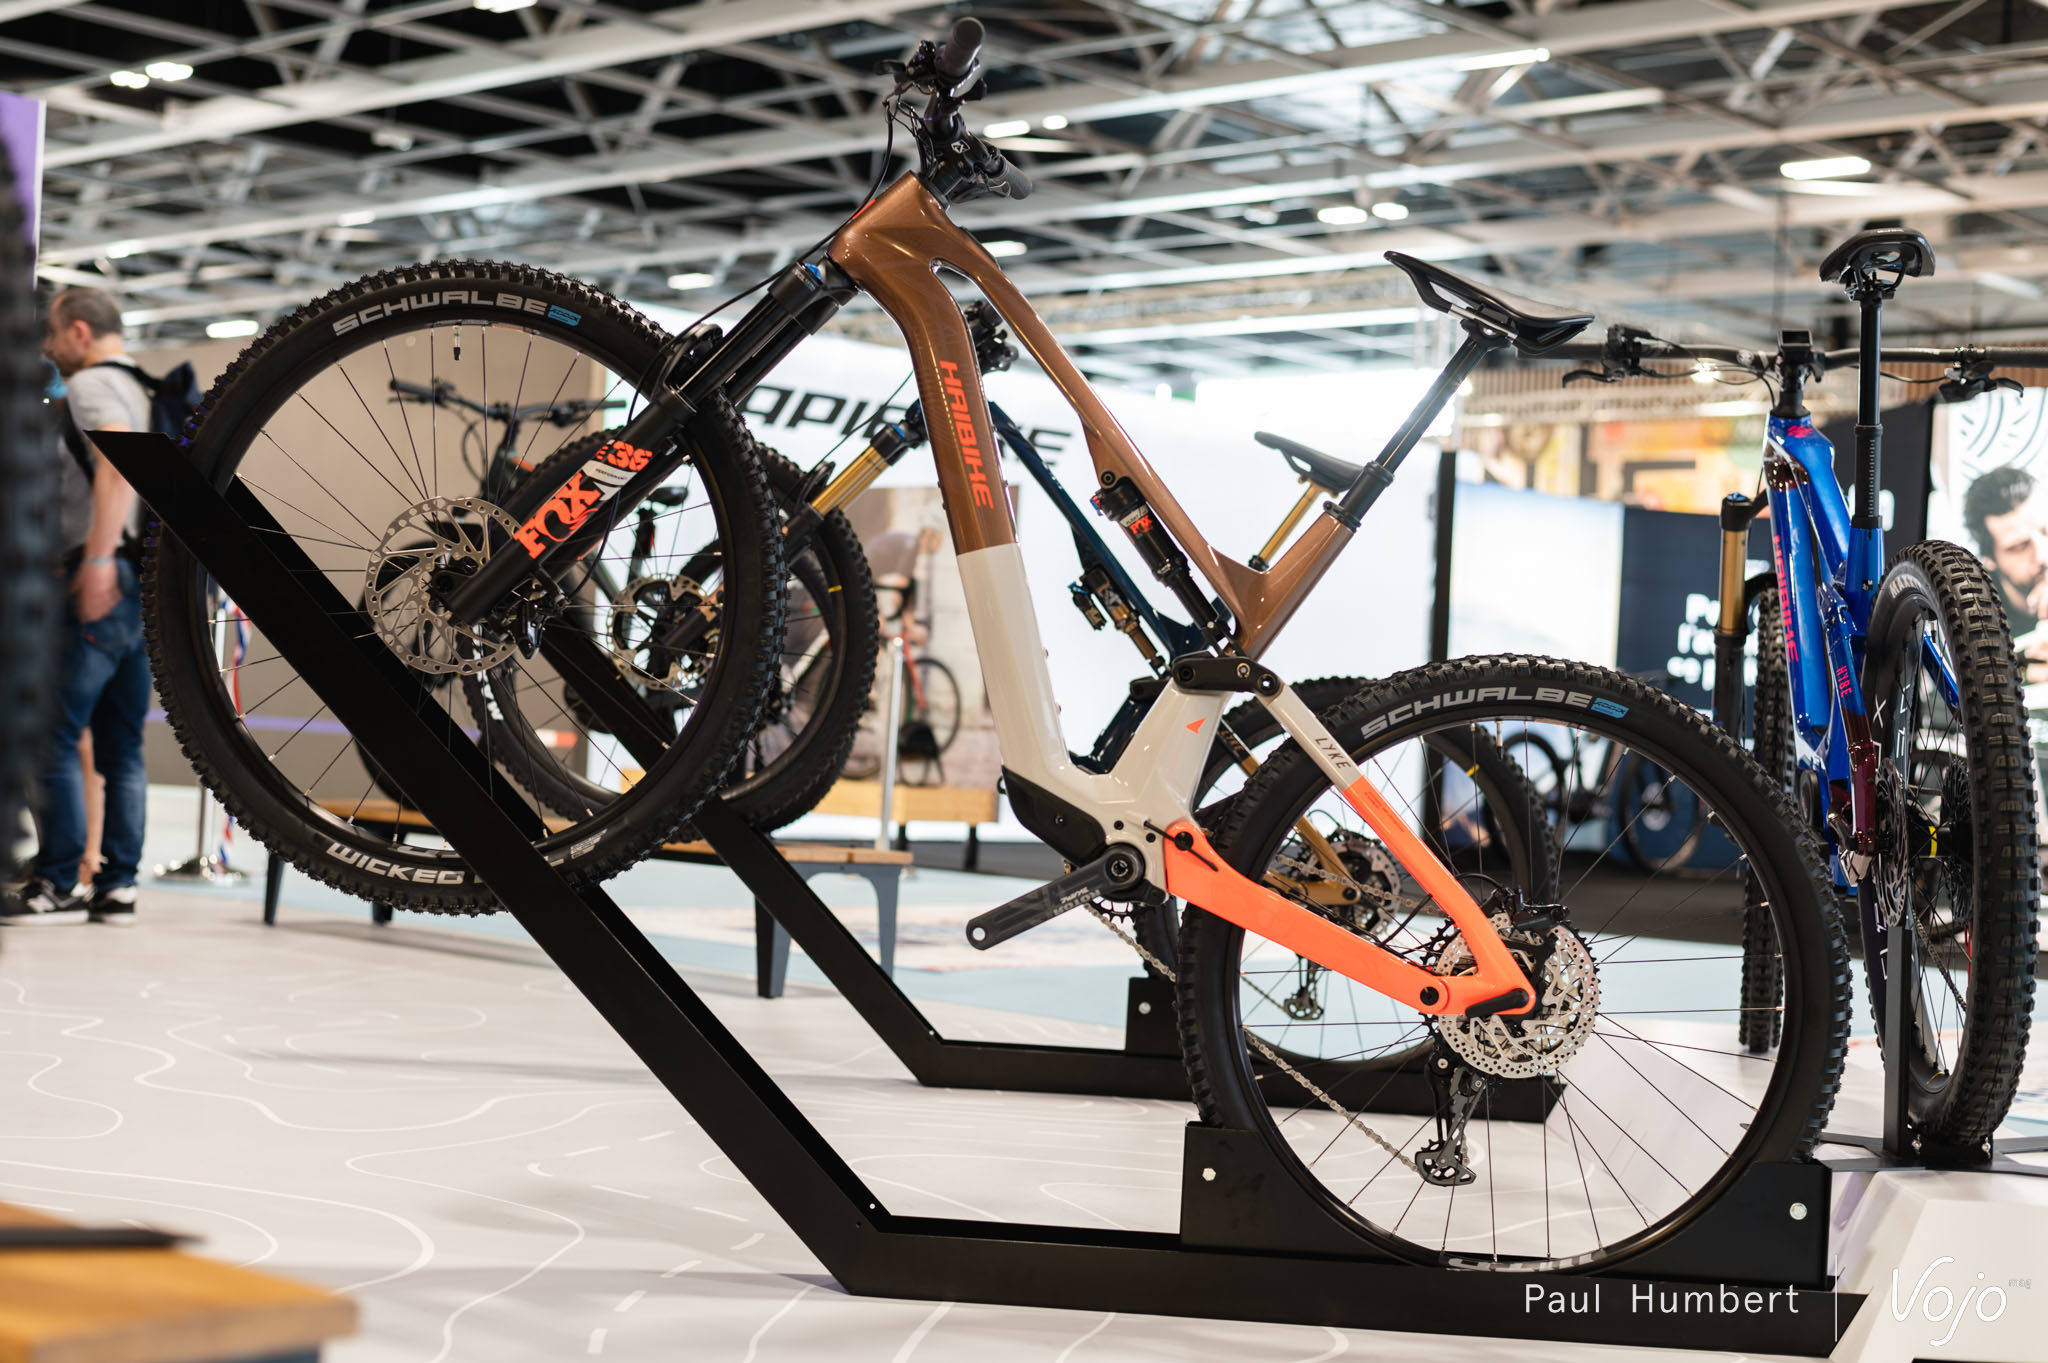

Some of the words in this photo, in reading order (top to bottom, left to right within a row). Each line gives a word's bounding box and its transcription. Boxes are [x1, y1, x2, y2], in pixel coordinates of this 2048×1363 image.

[332, 290, 548, 336] SCHWALBE
[607, 440, 654, 471] 36
[939, 359, 994, 510] HAIBIKE
[513, 471, 604, 560] FOX
[1360, 686, 1593, 740] SCHWALBE
[1314, 736, 1351, 770] LYKE
[326, 841, 465, 885] WICKED
